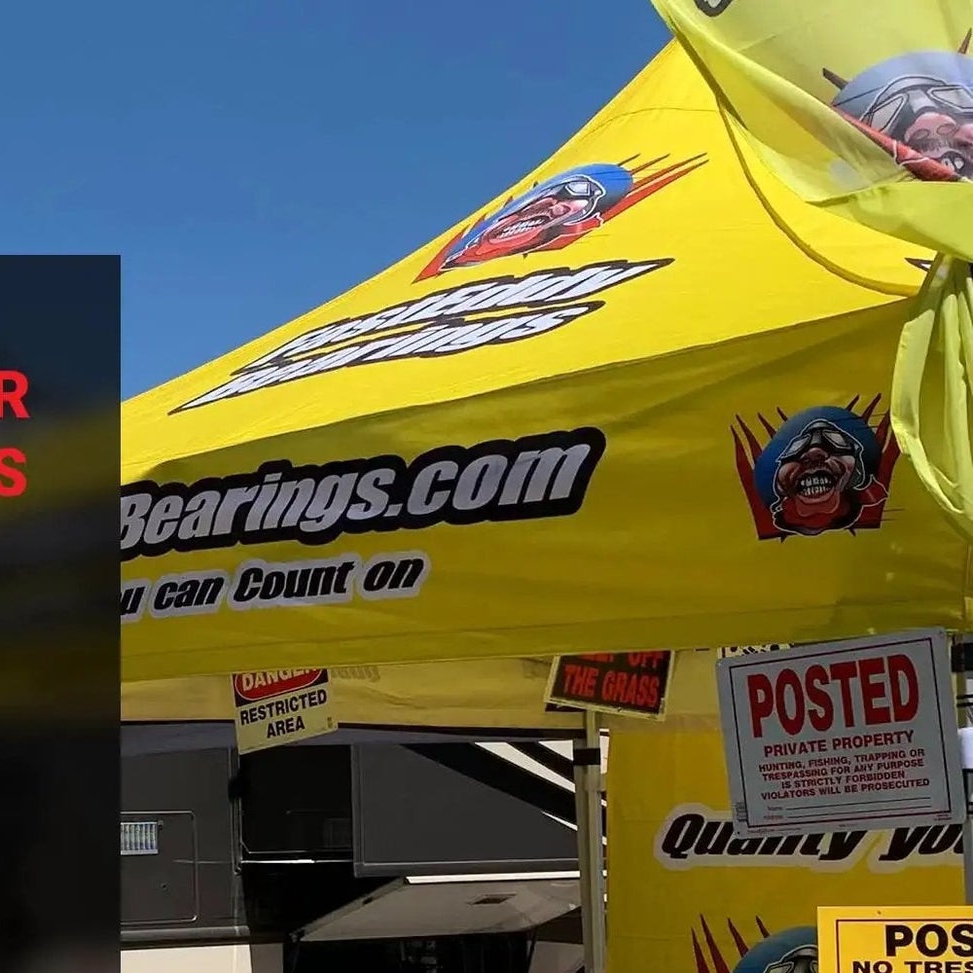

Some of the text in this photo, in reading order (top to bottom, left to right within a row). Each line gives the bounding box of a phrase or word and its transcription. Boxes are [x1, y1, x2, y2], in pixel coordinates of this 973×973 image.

[120, 444, 591, 549] Bearings.com
[154, 577, 225, 610] can
[233, 561, 355, 602] Count
[363, 558, 424, 591] on
[242, 668, 318, 692] DANG
[563, 664, 659, 708] THE GRASS
[240, 689, 327, 726] RESTRICTED
[747, 654, 919, 737] POSTED
[266, 716, 305, 738] AREA
[764, 730, 915, 758] PRIVATE PROPERTY
[759, 748, 925, 773] HUNTING, FISHING, TRAPPING OR
[762, 759, 924, 782] TRESPASSING FOR ANY PURPOSE
[761, 778, 930, 800] VIOLATORS WILL BE PROSECUTED
[781, 770, 905, 789] IS STRICTLY FORBIDDEN
